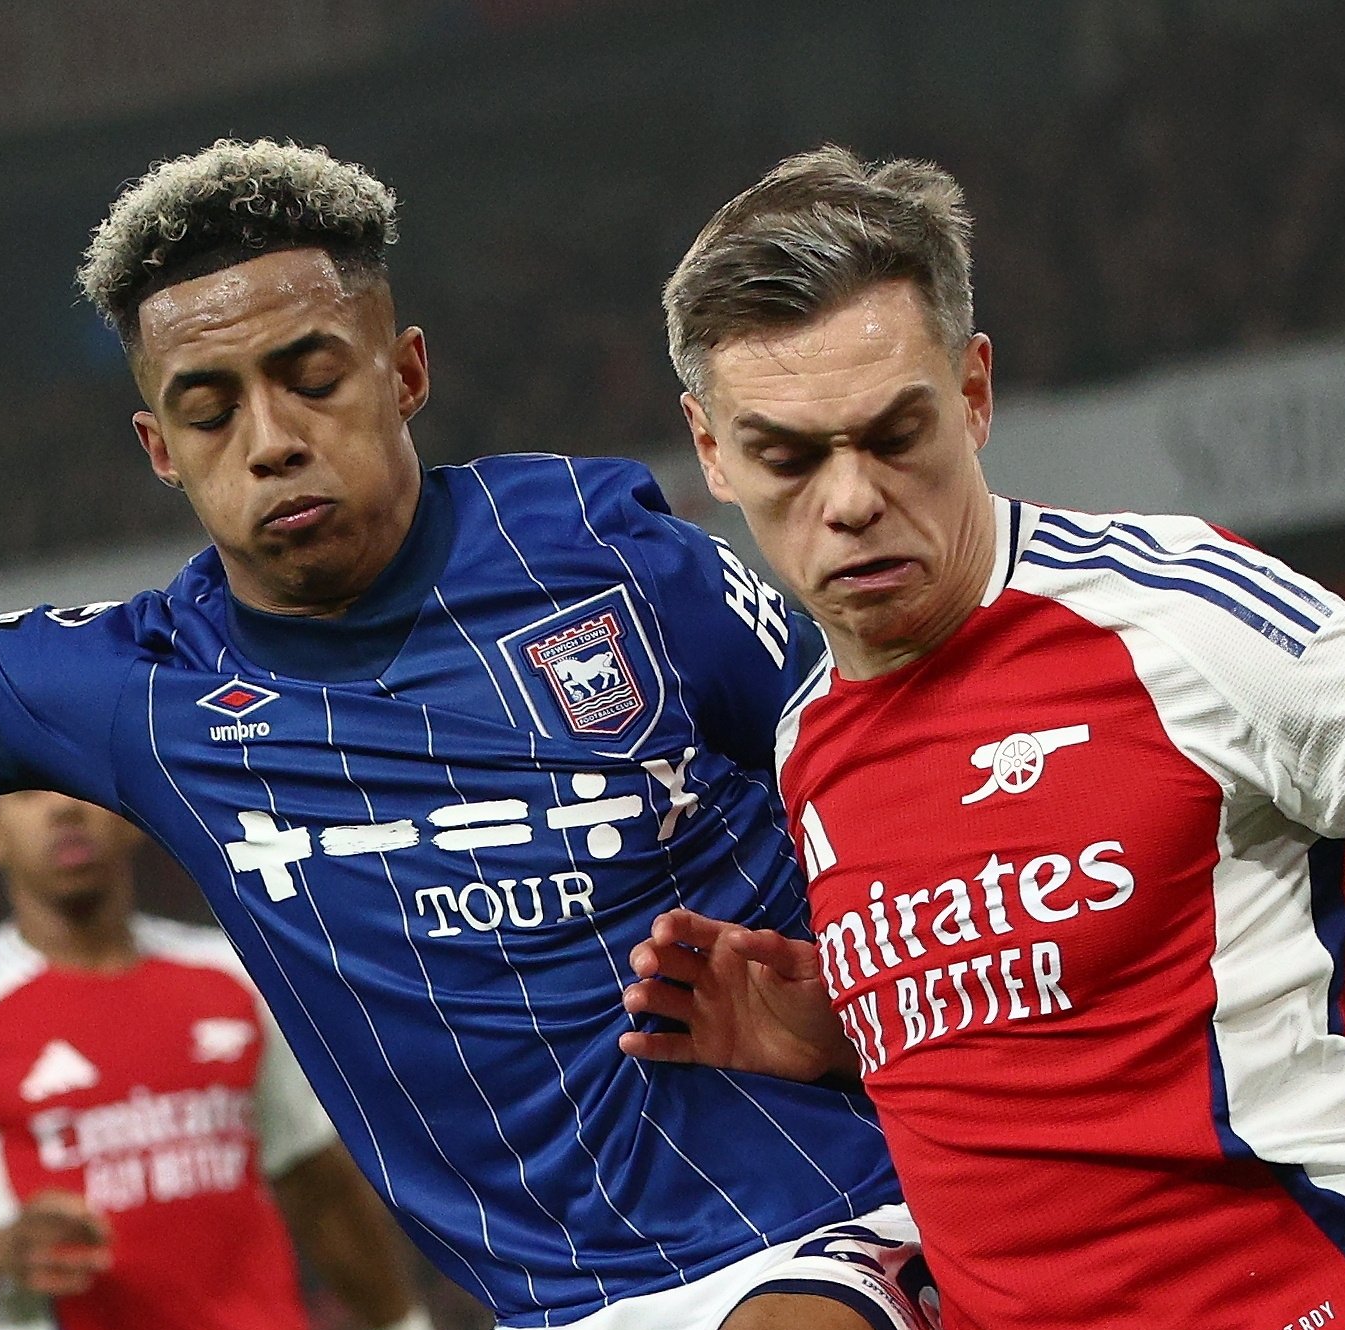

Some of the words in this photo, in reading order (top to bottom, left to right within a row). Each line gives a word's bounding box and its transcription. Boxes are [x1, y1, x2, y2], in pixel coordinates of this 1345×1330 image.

[542, 640, 579, 660] IPSWICH
[580, 627, 607, 645] TOWN
[209, 722, 270, 743] umbro
[579, 708, 616, 726] FOOTBALL
[615, 700, 635, 714] CLUB
[415, 872, 597, 938] TOUR
[817, 841, 1135, 1000] mirates
[896, 941, 1073, 1051] BETTER
